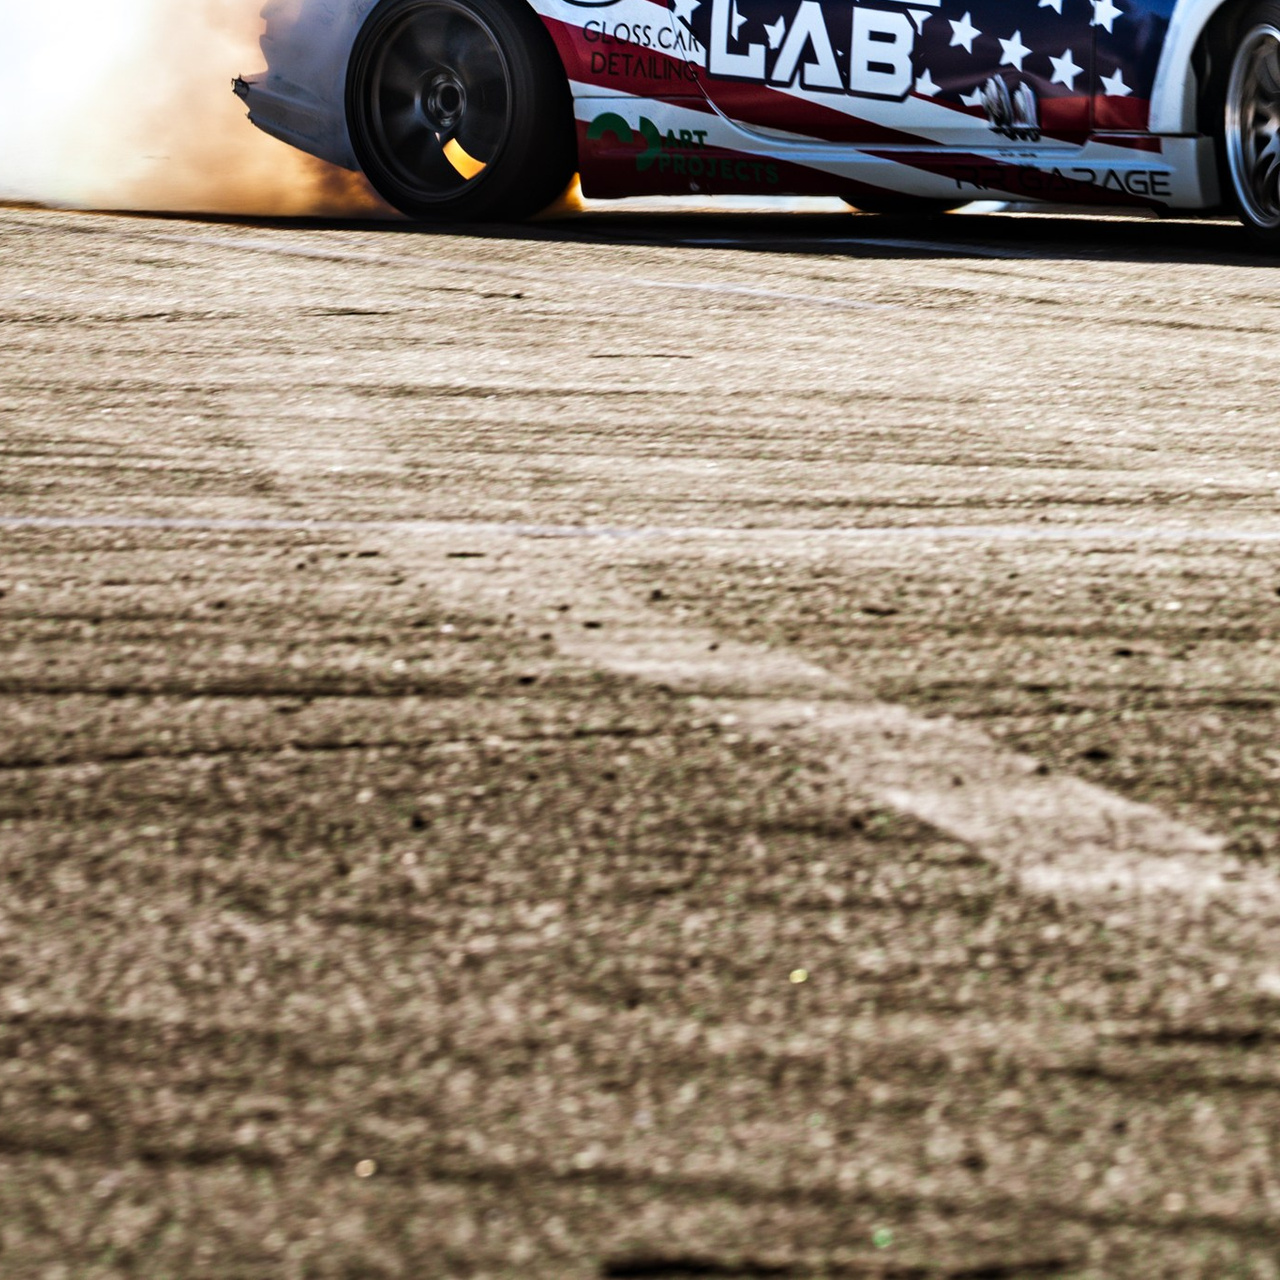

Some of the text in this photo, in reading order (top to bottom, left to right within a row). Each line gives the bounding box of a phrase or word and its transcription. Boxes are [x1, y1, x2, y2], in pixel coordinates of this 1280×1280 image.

[590, 51, 698, 83] DETAILING
[664, 128, 709, 153] ART
[658, 154, 780, 185] PROJECTS
